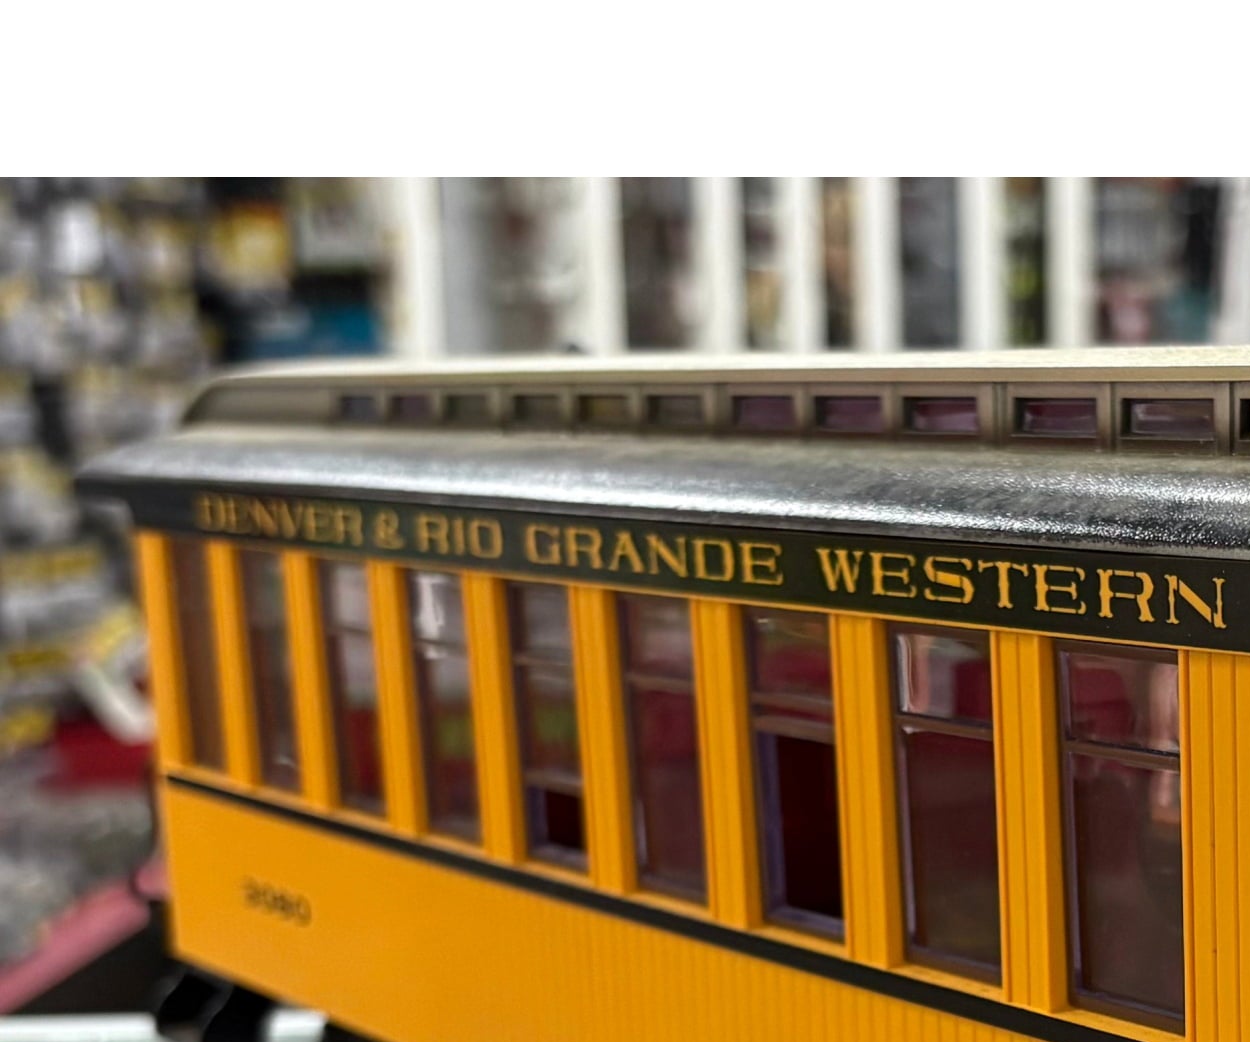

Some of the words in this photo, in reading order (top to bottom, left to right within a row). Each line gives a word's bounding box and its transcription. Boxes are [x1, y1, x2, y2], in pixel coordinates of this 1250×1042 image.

[195, 495, 364, 546] DENVER
[374, 508, 404, 549] &
[414, 512, 503, 559] RIO
[524, 522, 783, 586] GRANDE
[816, 548, 1227, 629] WESTERN
